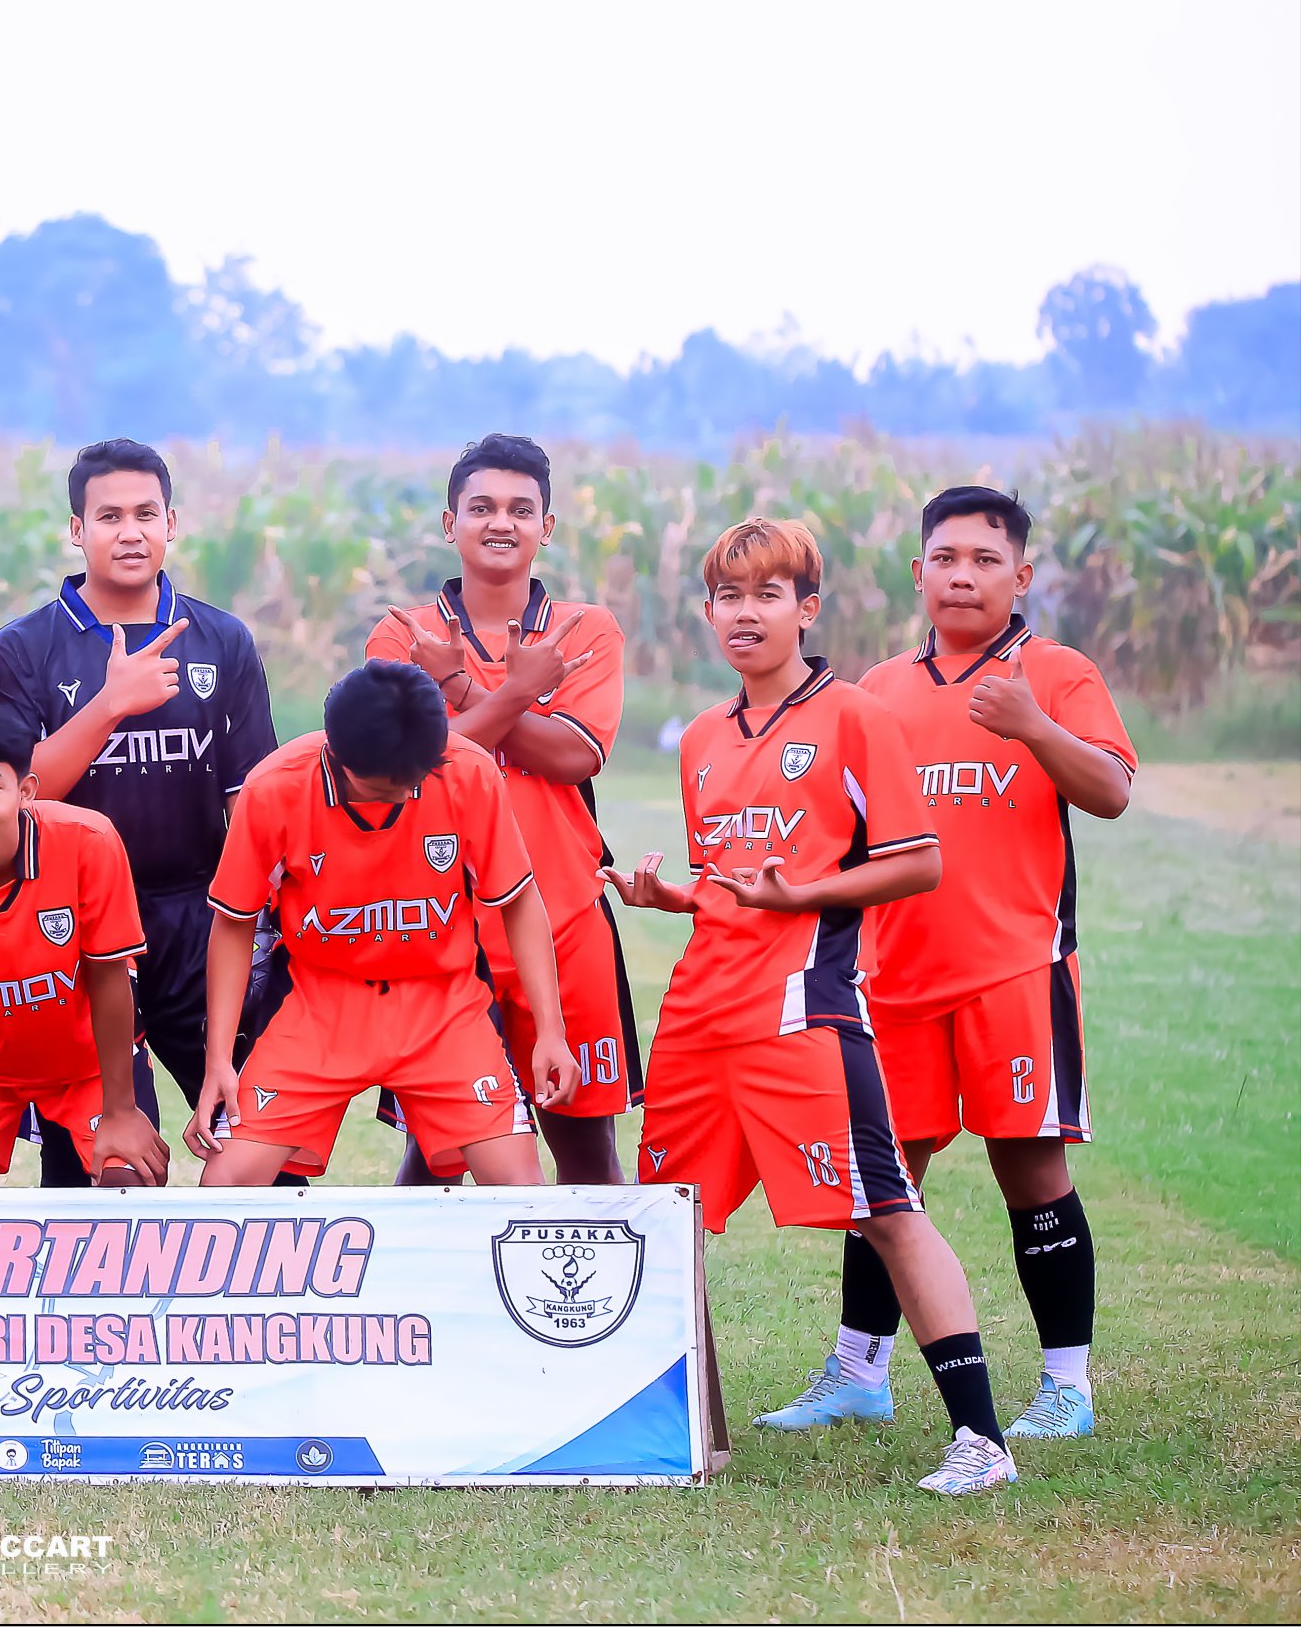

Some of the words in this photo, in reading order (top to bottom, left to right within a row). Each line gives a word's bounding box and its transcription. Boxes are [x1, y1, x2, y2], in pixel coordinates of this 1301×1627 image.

[90, 728, 214, 766] ZMOV
[915, 761, 1020, 797] MOV
[928, 797, 1017, 809] AREL
[702, 841, 799, 857] PAREL
[303, 892, 460, 935] AZMOV
[297, 931, 438, 945] APPARE
[578, 1036, 620, 1087] 19
[521, 1229, 615, 1240] PUSAKA
[545, 1303, 594, 1313] KANGKUNG
[554, 1318, 586, 1329] 1963
[34, 1313, 160, 1365] DESA
[166, 1313, 432, 1366] KANGKUNG
[0, 1372, 234, 1422] Sportivitas
[40, 1439, 82, 1458] Titipan
[41, 1453, 82, 1471] Bapak
